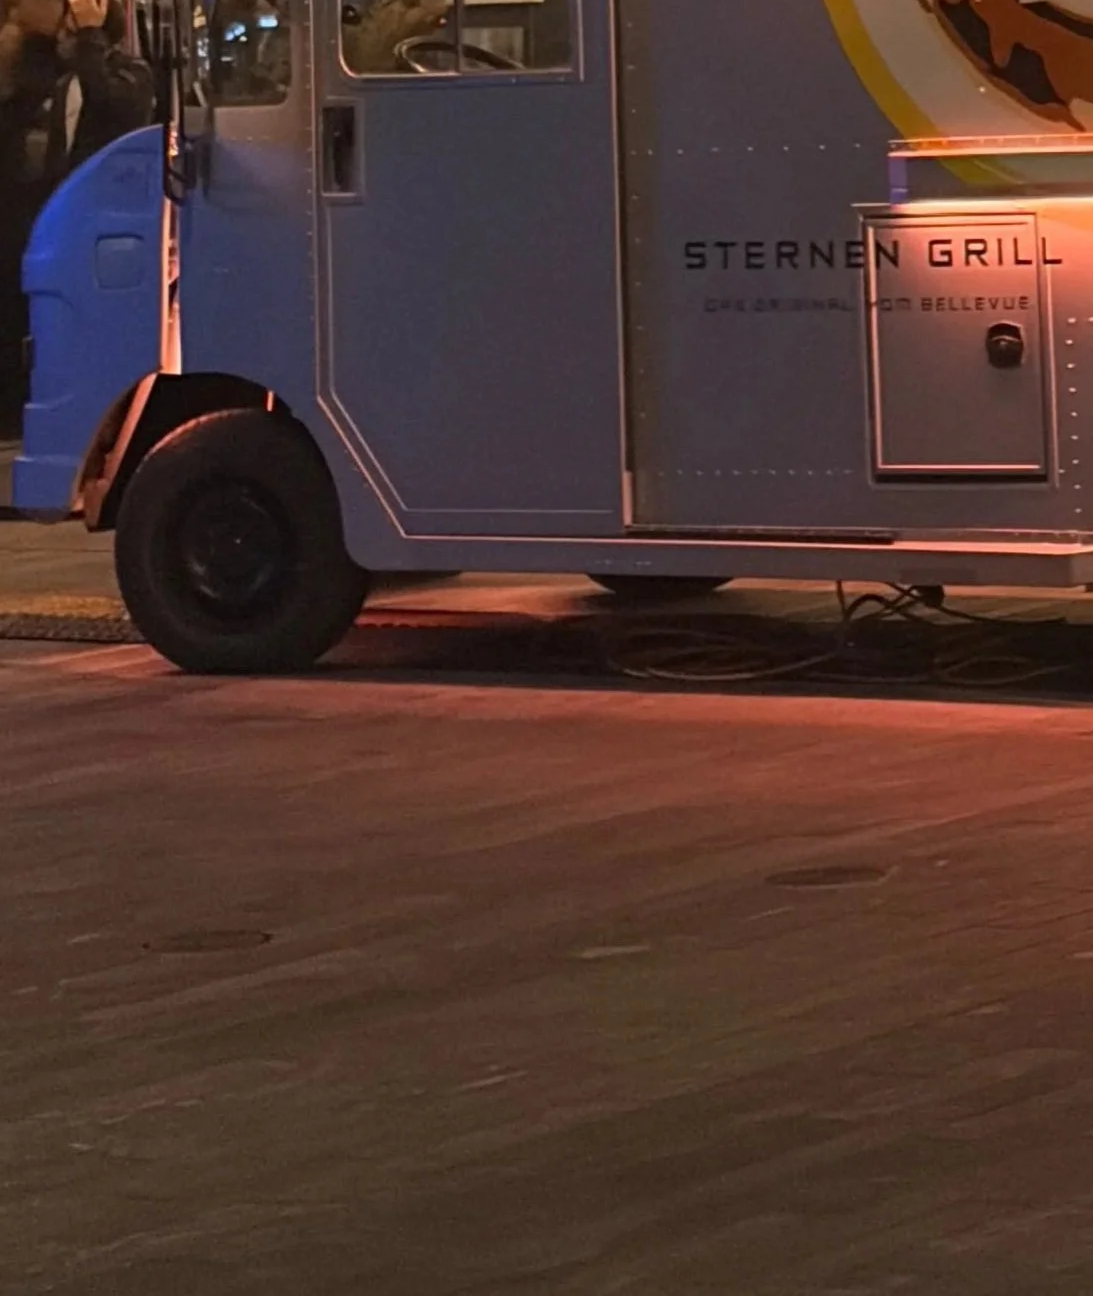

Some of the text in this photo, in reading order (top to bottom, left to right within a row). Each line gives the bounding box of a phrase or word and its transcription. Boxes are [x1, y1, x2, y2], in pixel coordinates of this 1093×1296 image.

[684, 236, 1063, 270] STERNEN GRILL
[920, 295, 1031, 312] BELLEVUE
